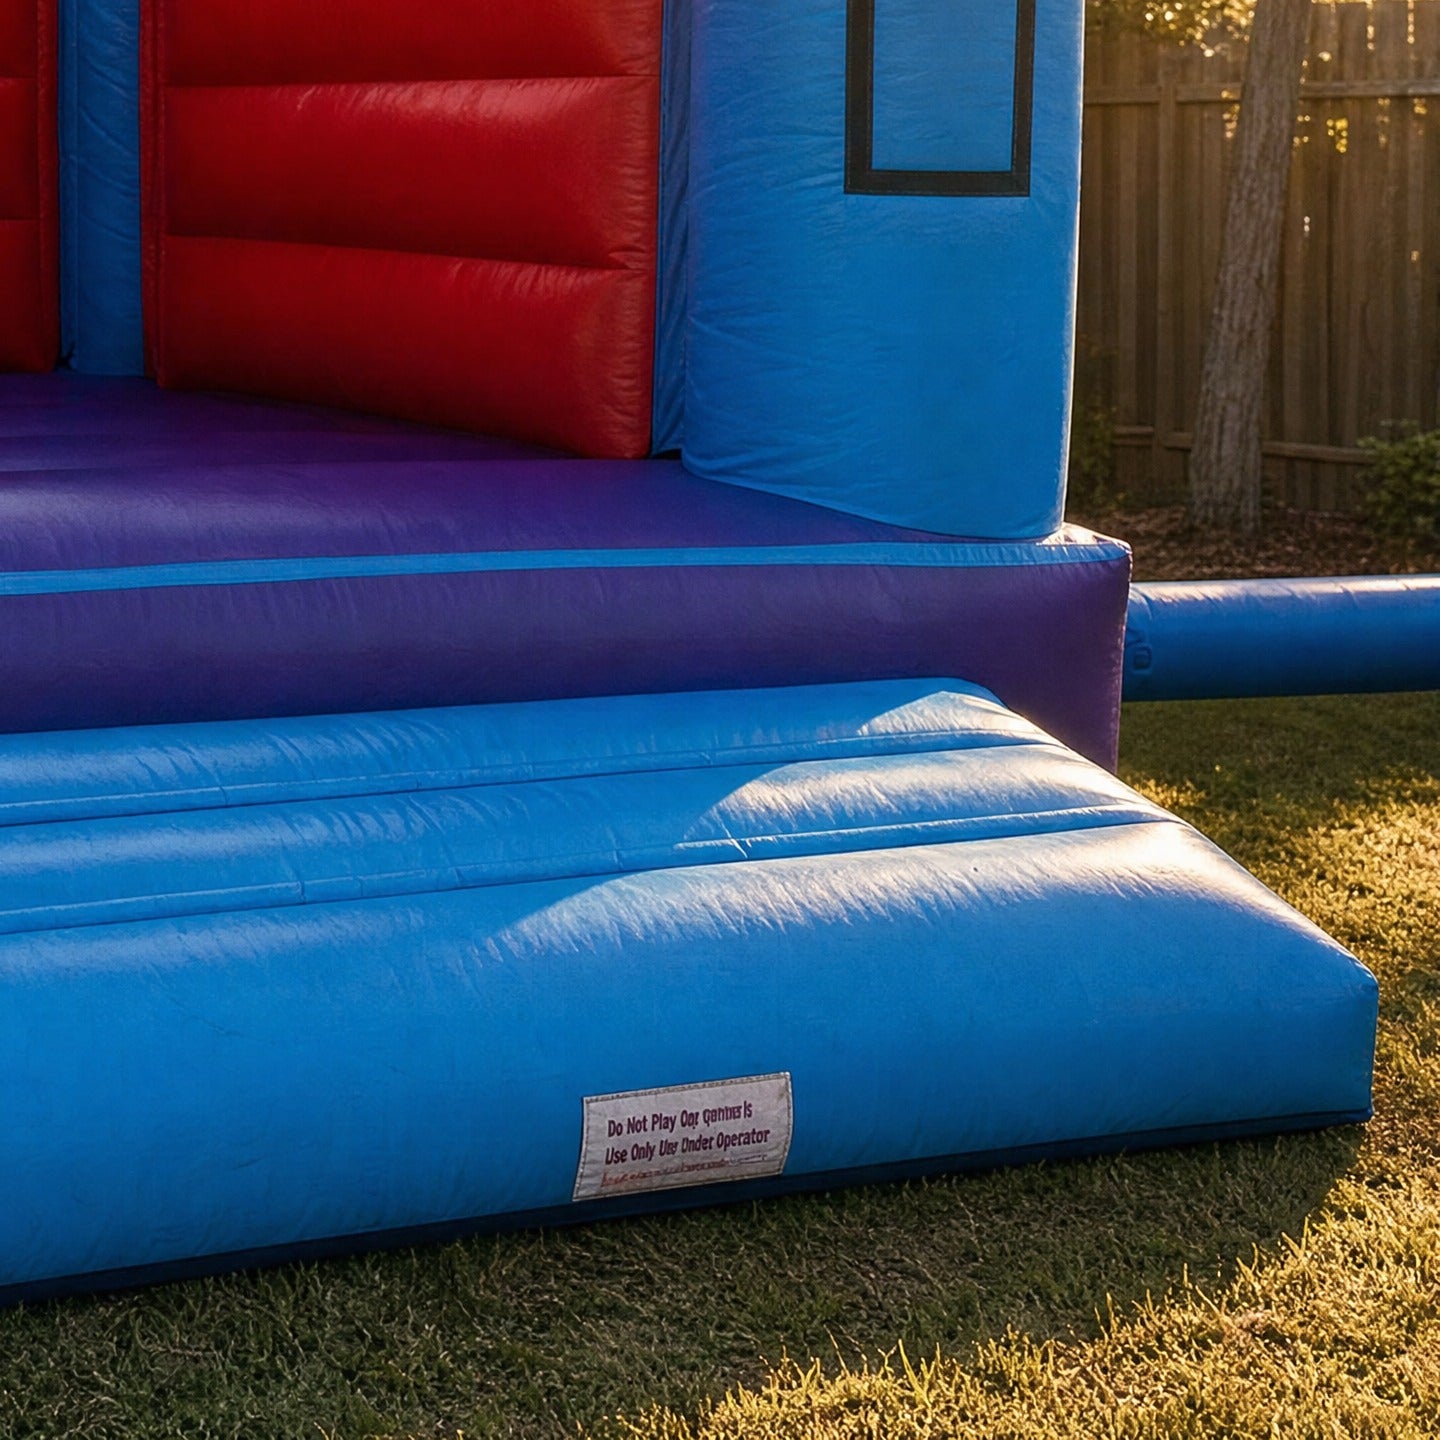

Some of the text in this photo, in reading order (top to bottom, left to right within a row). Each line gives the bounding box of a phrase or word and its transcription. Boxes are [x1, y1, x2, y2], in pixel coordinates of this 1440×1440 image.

[608, 1120, 623, 1137] Do
[627, 1117, 648, 1135] Not
[651, 1113, 677, 1134] Play
[605, 1148, 628, 1165] Use
[631, 1142, 656, 1162] Only
[717, 1128, 770, 1151] Operator
